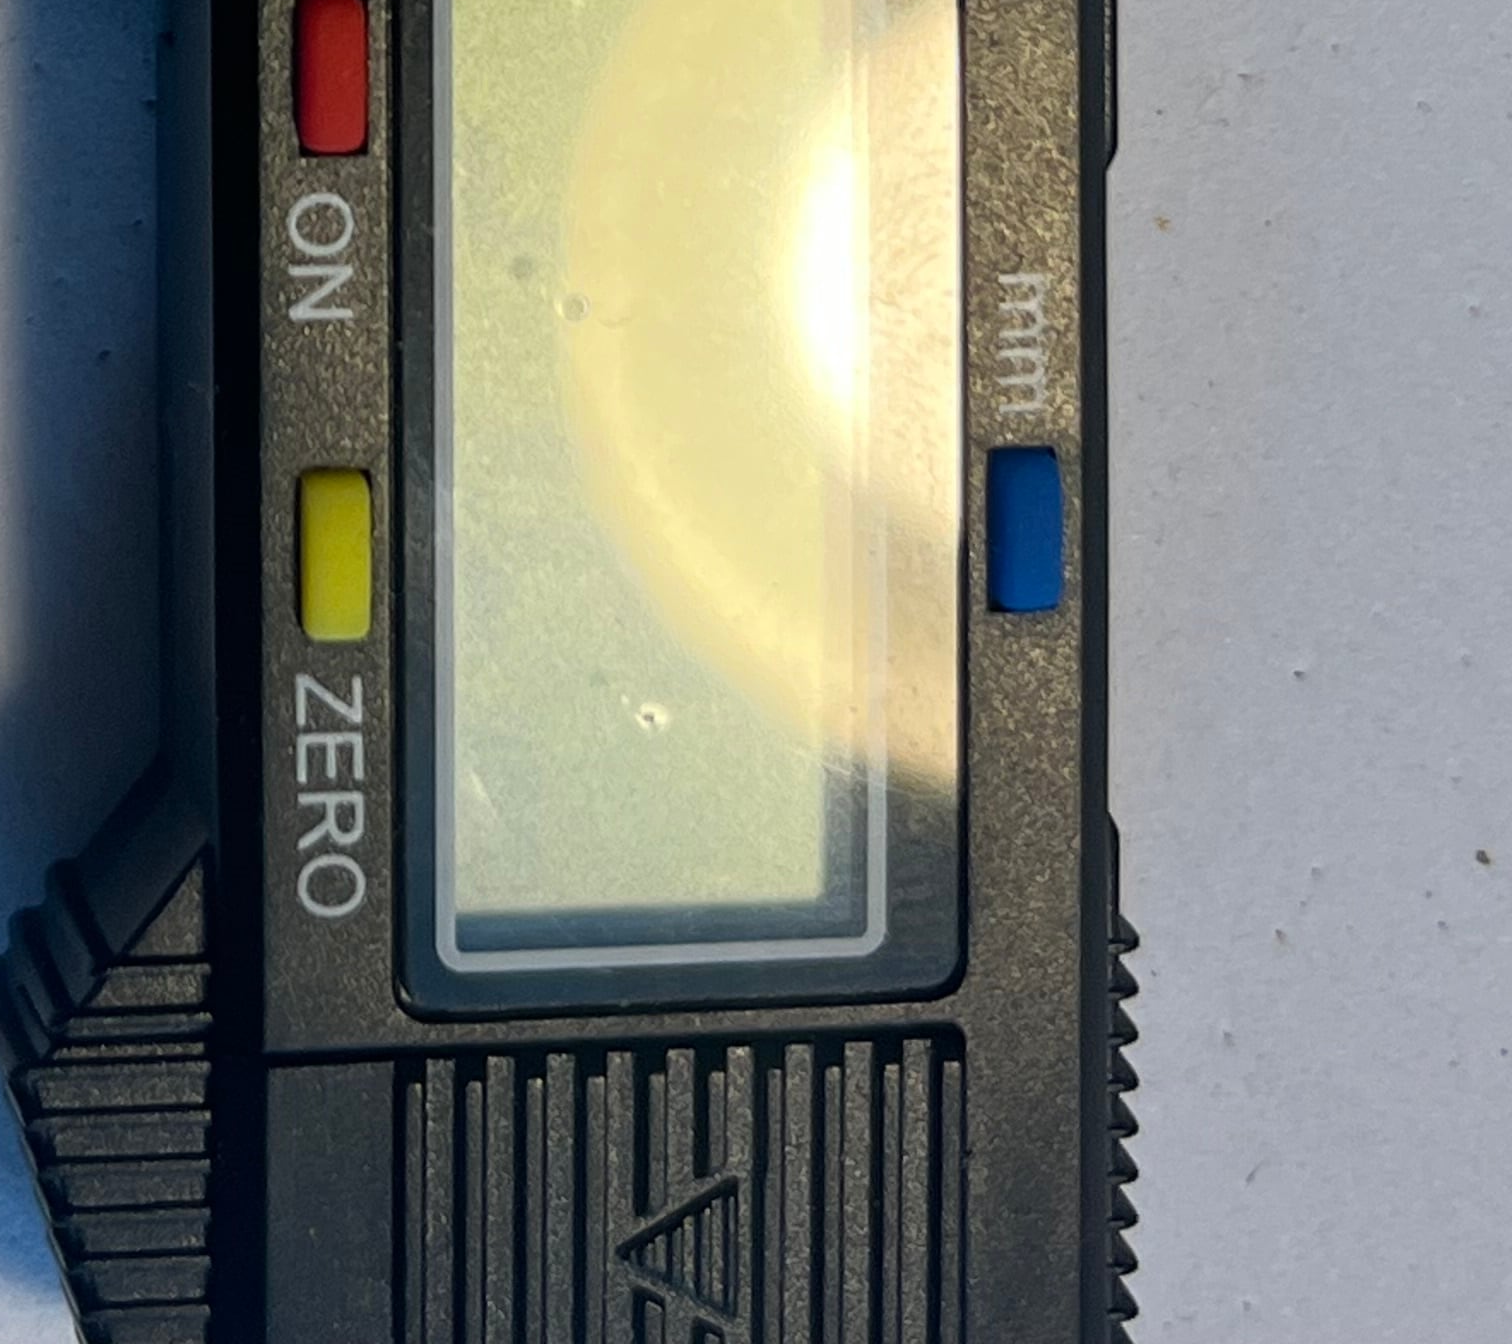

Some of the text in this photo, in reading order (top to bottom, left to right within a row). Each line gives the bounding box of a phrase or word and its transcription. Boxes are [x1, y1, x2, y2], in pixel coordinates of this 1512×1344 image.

[286, 190, 356, 322] ON
[998, 272, 1050, 413] mm
[295, 674, 367, 918] ZERO
